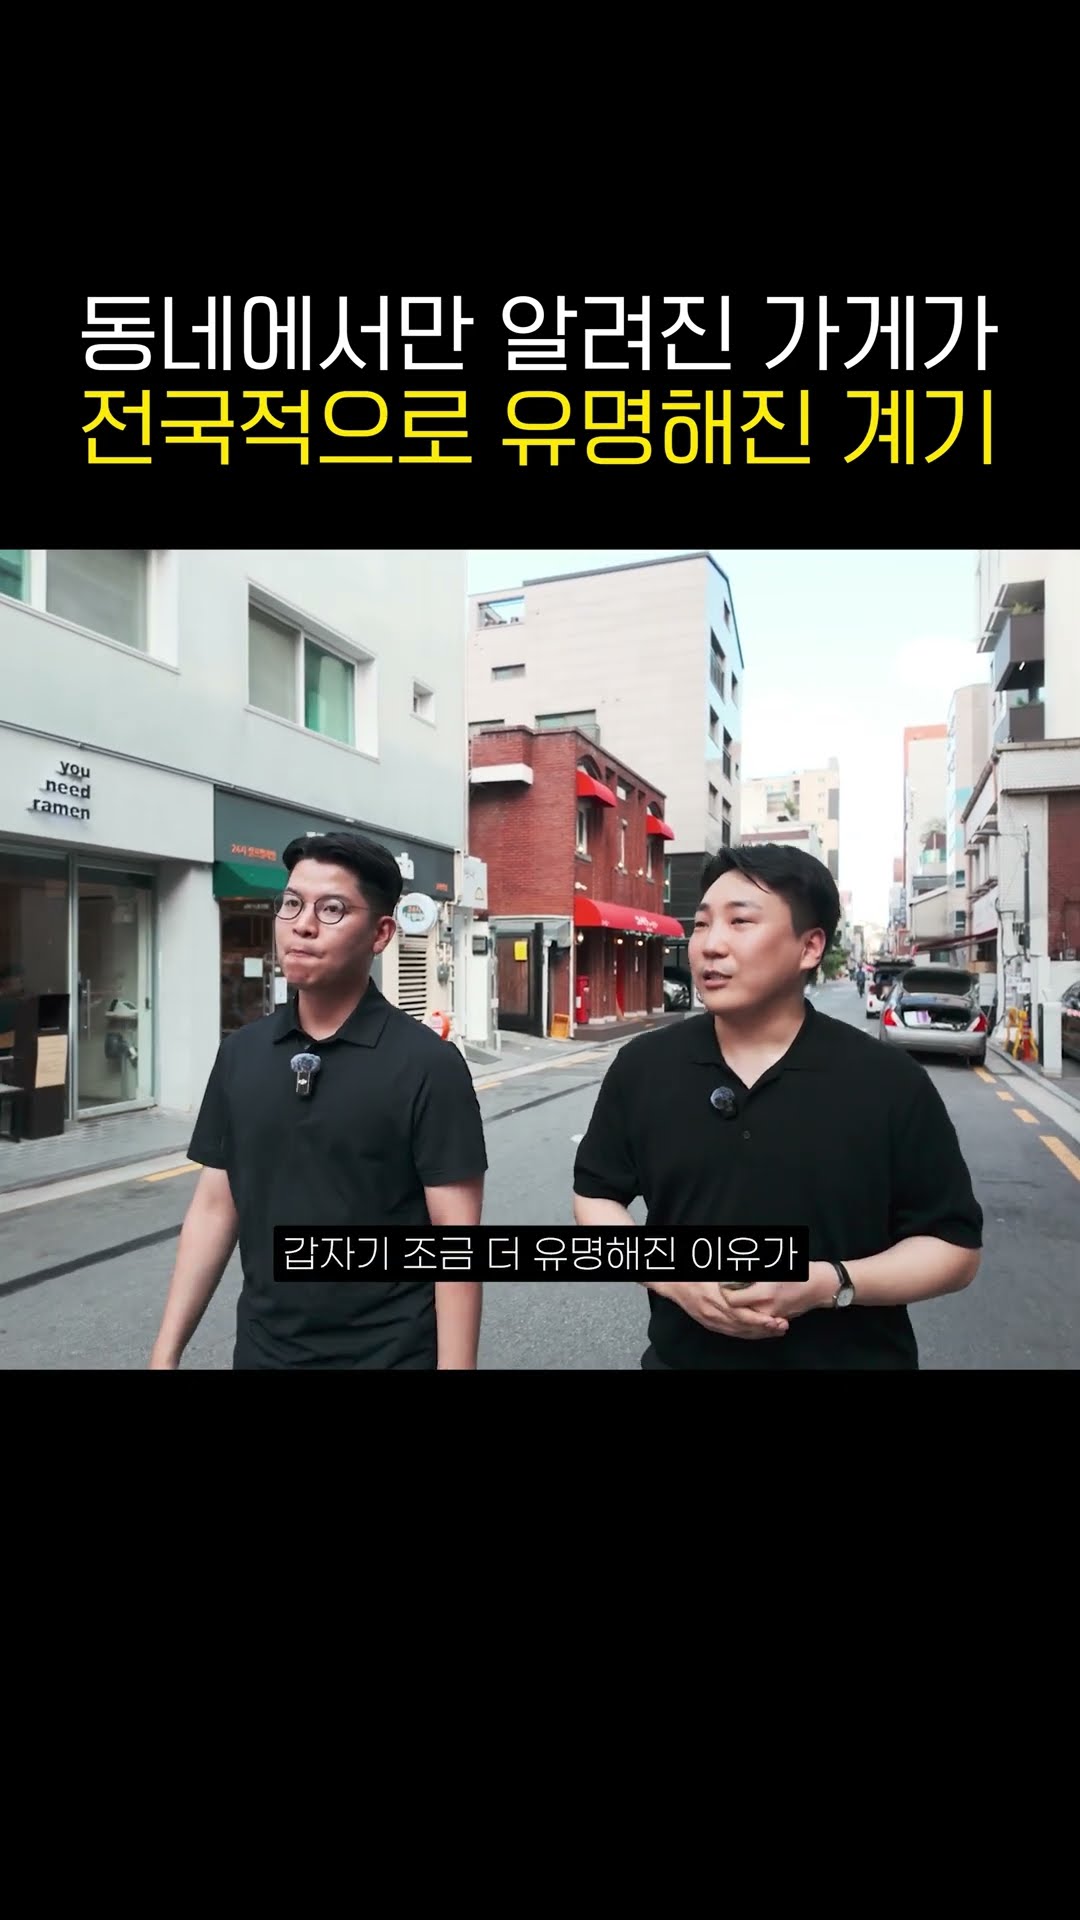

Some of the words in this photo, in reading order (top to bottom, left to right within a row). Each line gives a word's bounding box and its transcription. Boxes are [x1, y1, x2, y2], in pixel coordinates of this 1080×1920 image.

[58, 760, 90, 778] you
[46, 779, 91, 799] need
[33, 799, 90, 820] ramen
